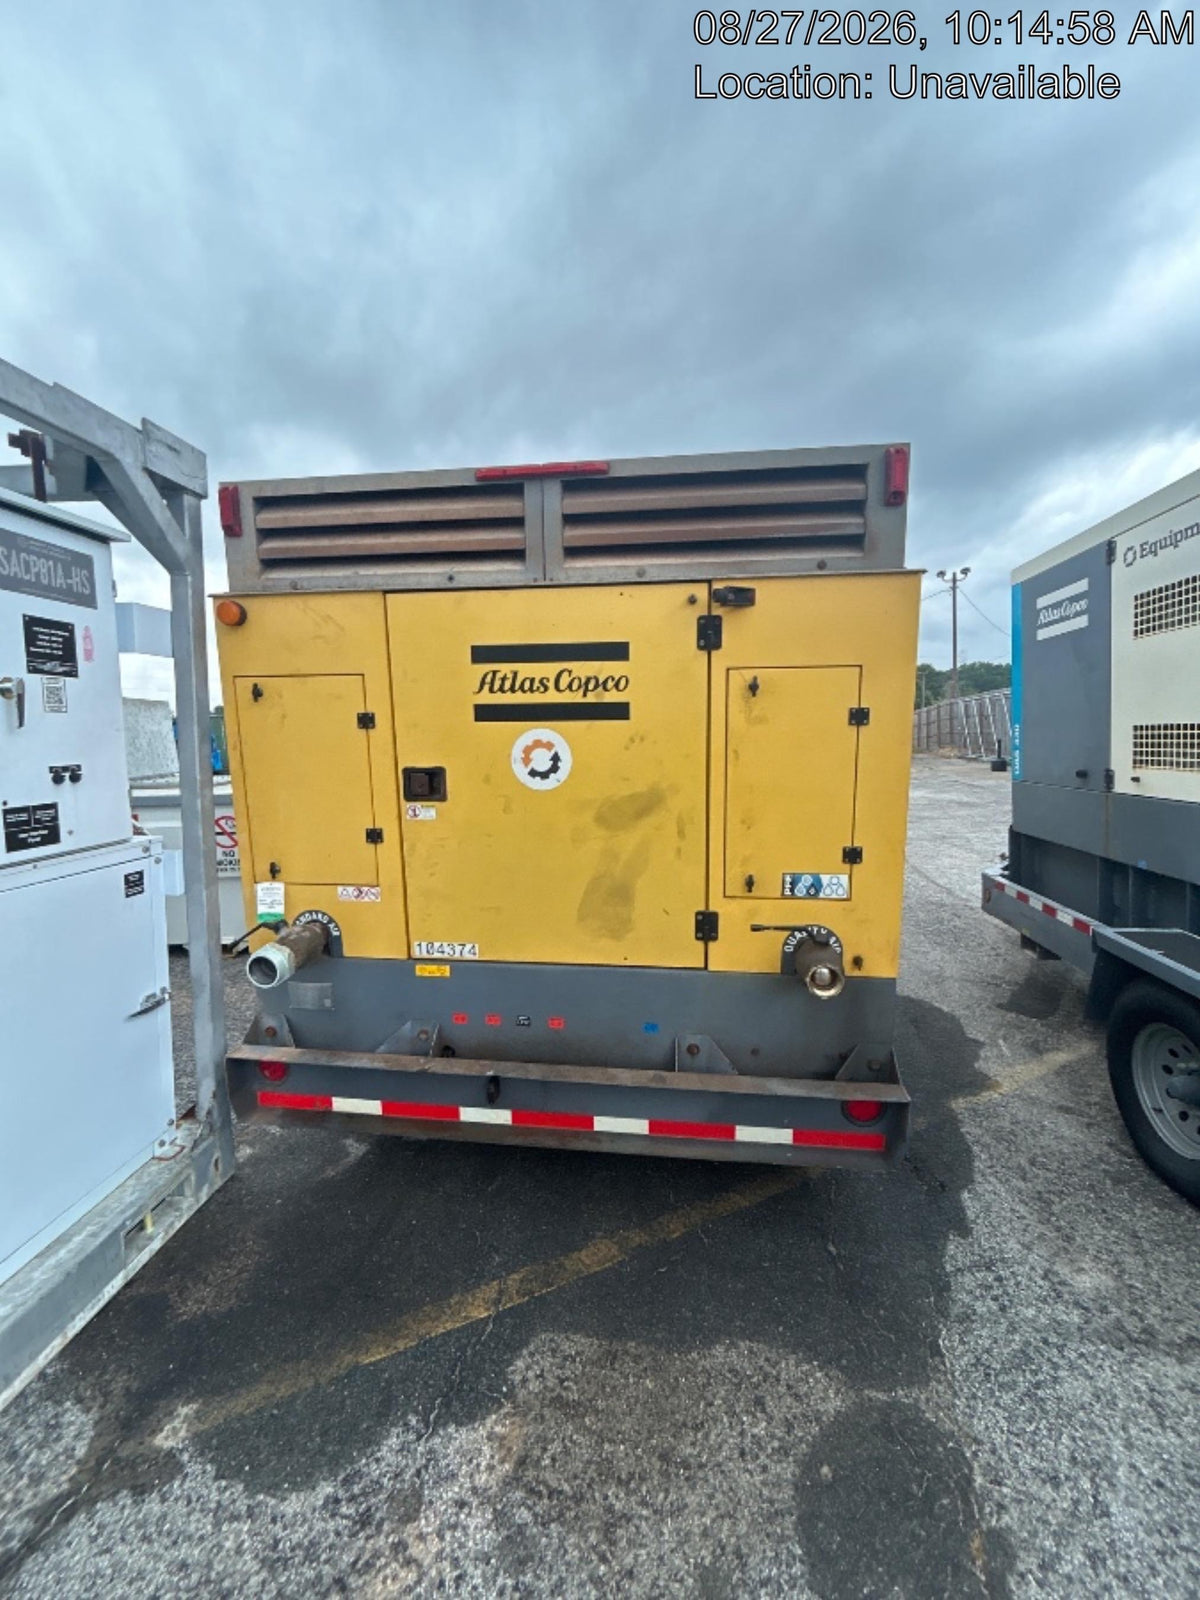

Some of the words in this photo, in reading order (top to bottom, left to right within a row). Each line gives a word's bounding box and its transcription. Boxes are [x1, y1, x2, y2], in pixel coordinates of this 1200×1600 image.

[473, 669, 550, 695] Atlas
[554, 668, 629, 698] Copco
[416, 942, 478, 958] 104374
